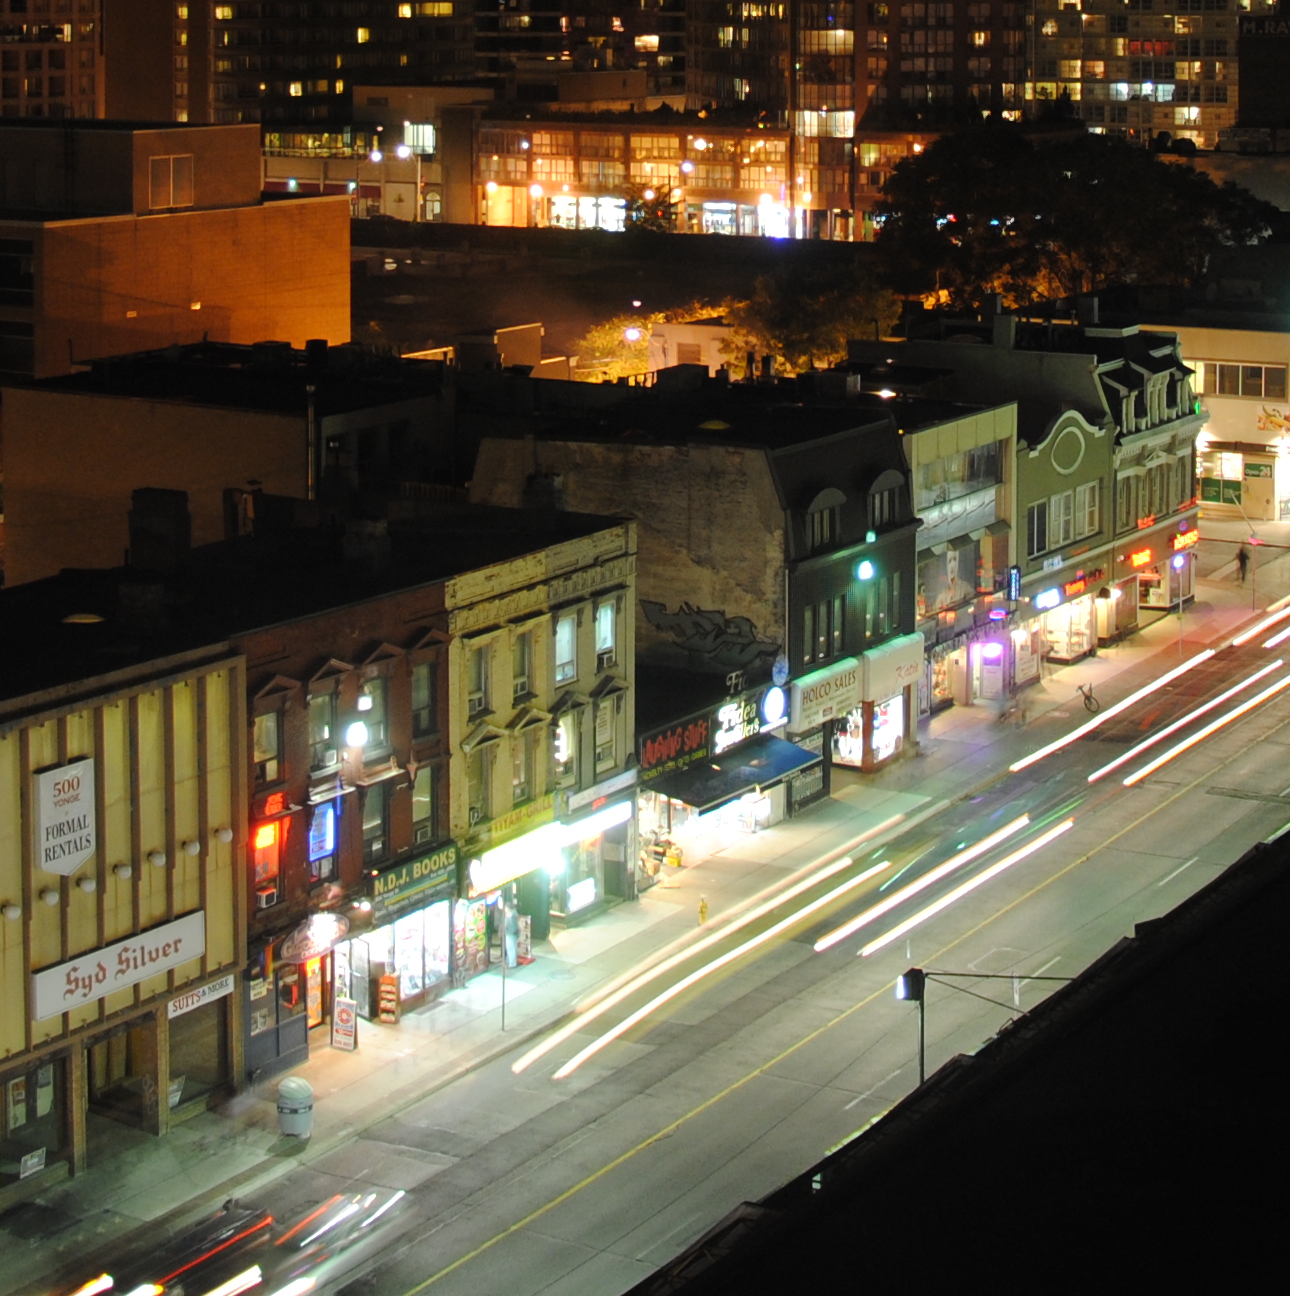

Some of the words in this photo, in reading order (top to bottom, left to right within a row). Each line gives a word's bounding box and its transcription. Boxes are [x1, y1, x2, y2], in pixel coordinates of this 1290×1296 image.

[802, 681, 831, 705] HOLCO
[834, 669, 857, 693] SALES
[684, 719, 708, 752] STUFF
[52, 775, 81, 799] 500
[53, 792, 81, 809] YONGE
[45, 814, 90, 842] FORMAL
[44, 832, 92, 863] RENTALS
[374, 868, 410, 896] N.D.J.
[413, 847, 456, 879] BOOKS
[63, 961, 107, 1001] Syd
[114, 936, 183, 981] Silver
[172, 990, 201, 1013] SUITS
[207, 977, 230, 996] MORE
